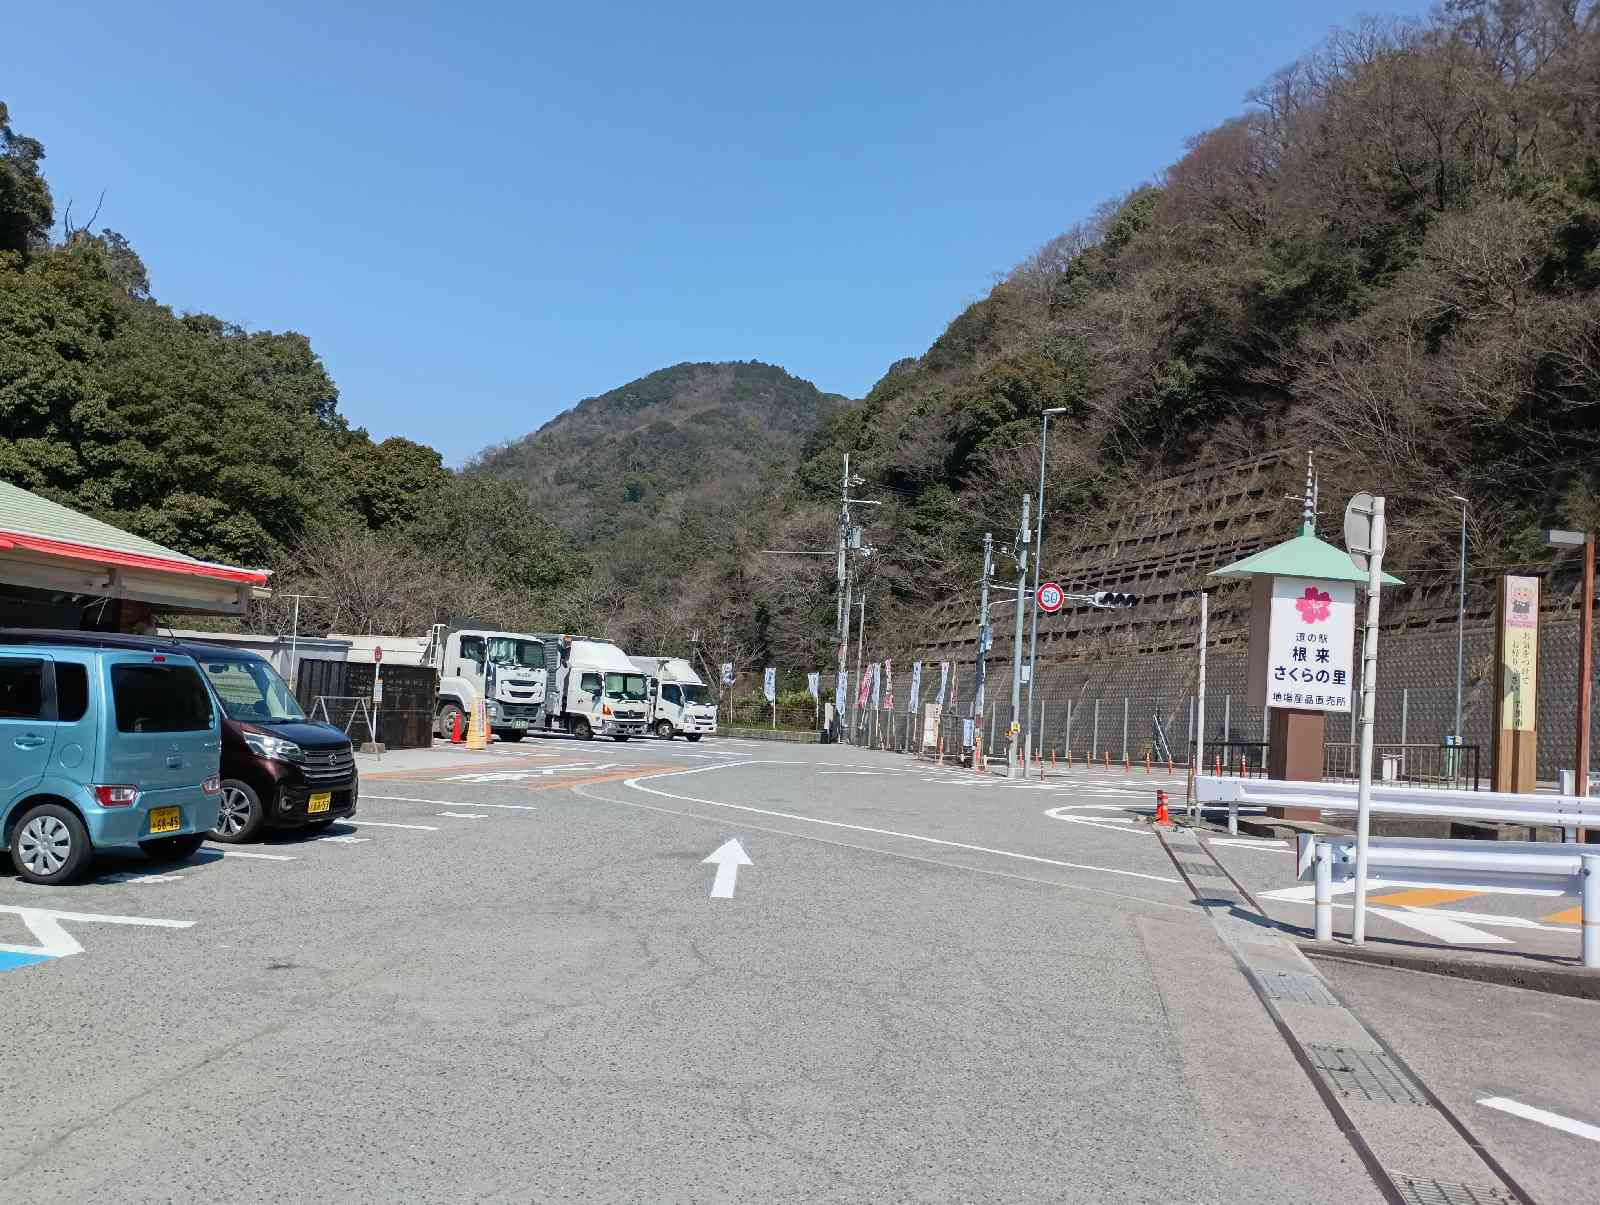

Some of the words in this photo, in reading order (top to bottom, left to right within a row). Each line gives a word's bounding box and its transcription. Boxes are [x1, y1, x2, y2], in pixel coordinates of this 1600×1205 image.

[1043, 590, 1058, 603] 50
[1295, 632, 1328, 644] 道の駅
[1292, 646, 1330, 663] 根来
[1274, 665, 1347, 685] さくらの里
[1272, 690, 1346, 706] 地場産品直売所
